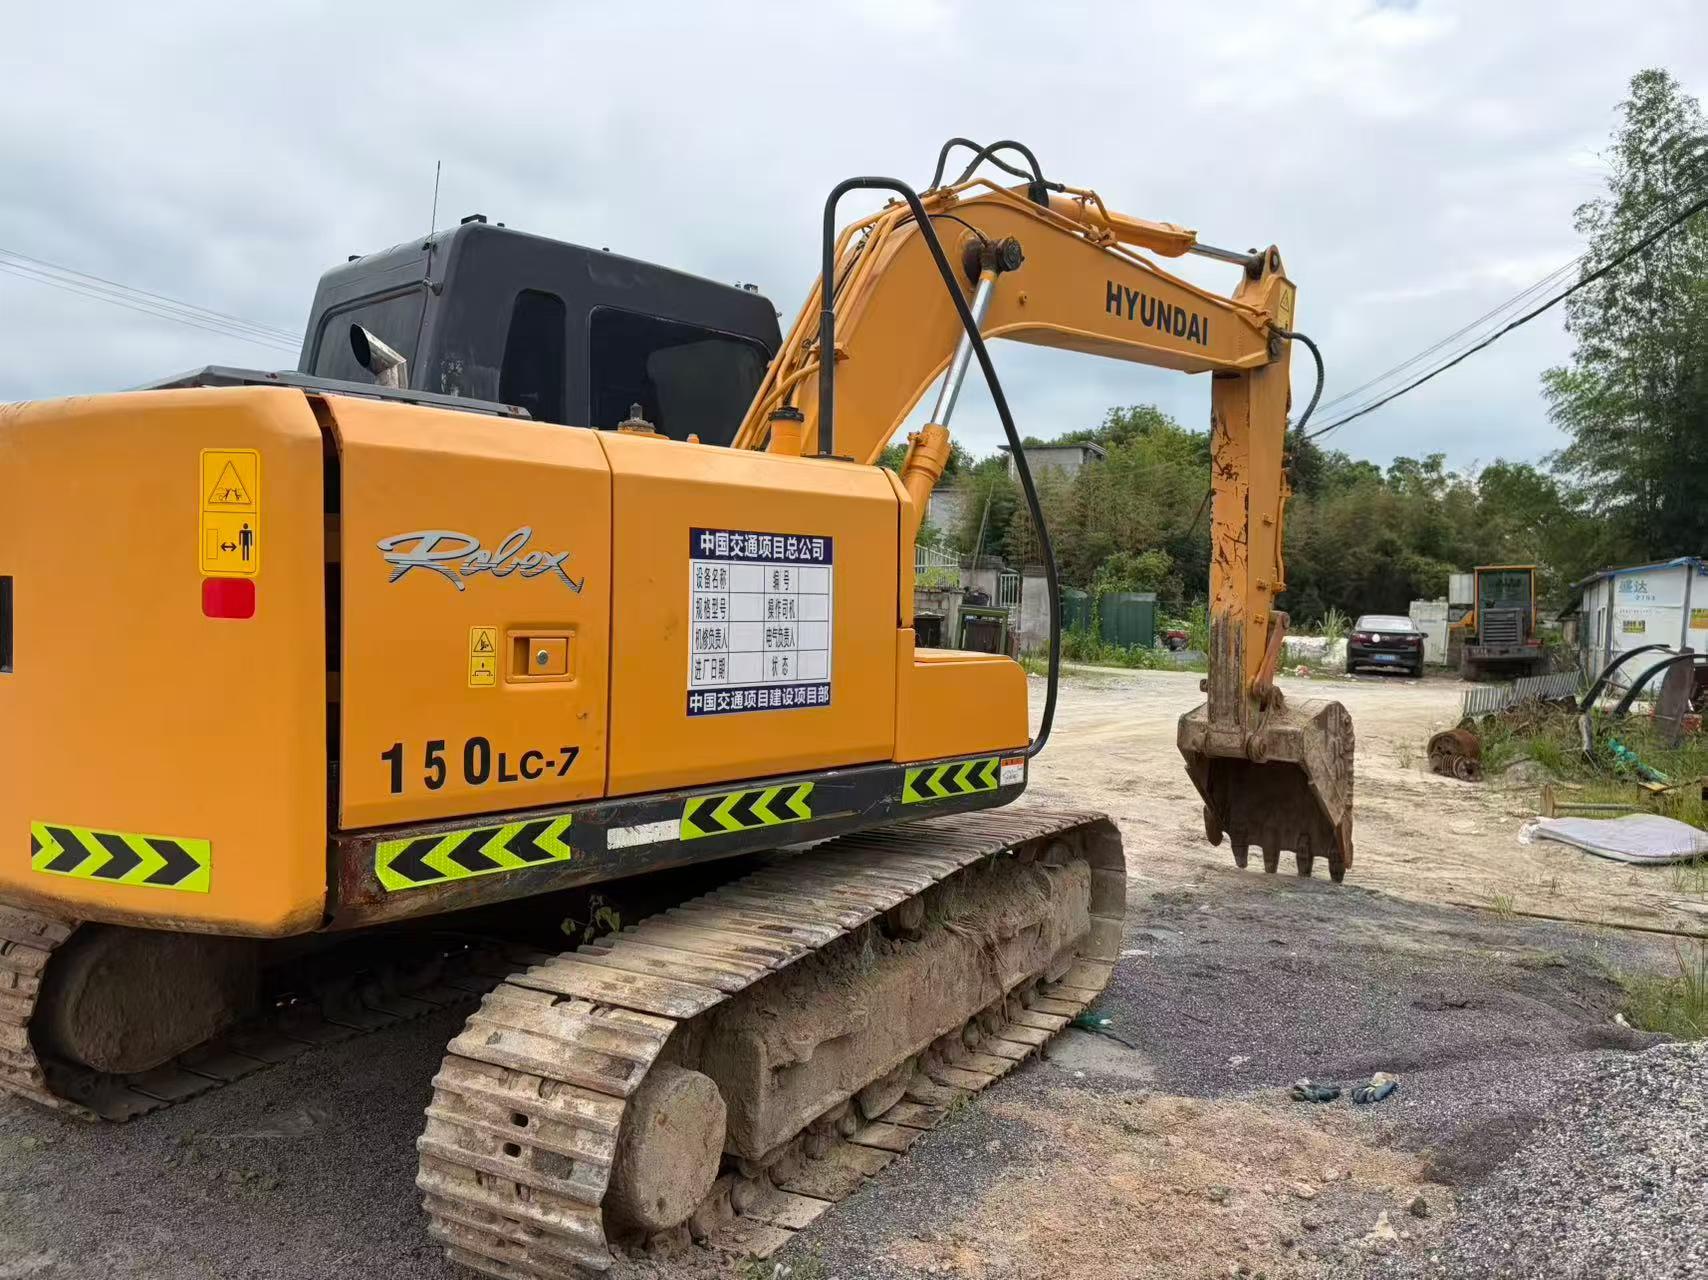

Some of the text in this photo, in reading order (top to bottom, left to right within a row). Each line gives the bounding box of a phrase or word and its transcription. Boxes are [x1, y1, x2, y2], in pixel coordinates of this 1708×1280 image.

[1105, 280, 1209, 346] HYUNDAI
[700, 530, 824, 561] 中国交通项目总公司
[377, 525, 584, 593] Robex
[696, 567, 727, 590] 设备名称
[773, 569, 790, 591] 编号
[695, 597, 727, 620] 规格型号
[767, 598, 795, 620] 操作司机
[695, 627, 728, 650] 机修负责人
[689, 685, 829, 713] 中国交通项目建设项目部
